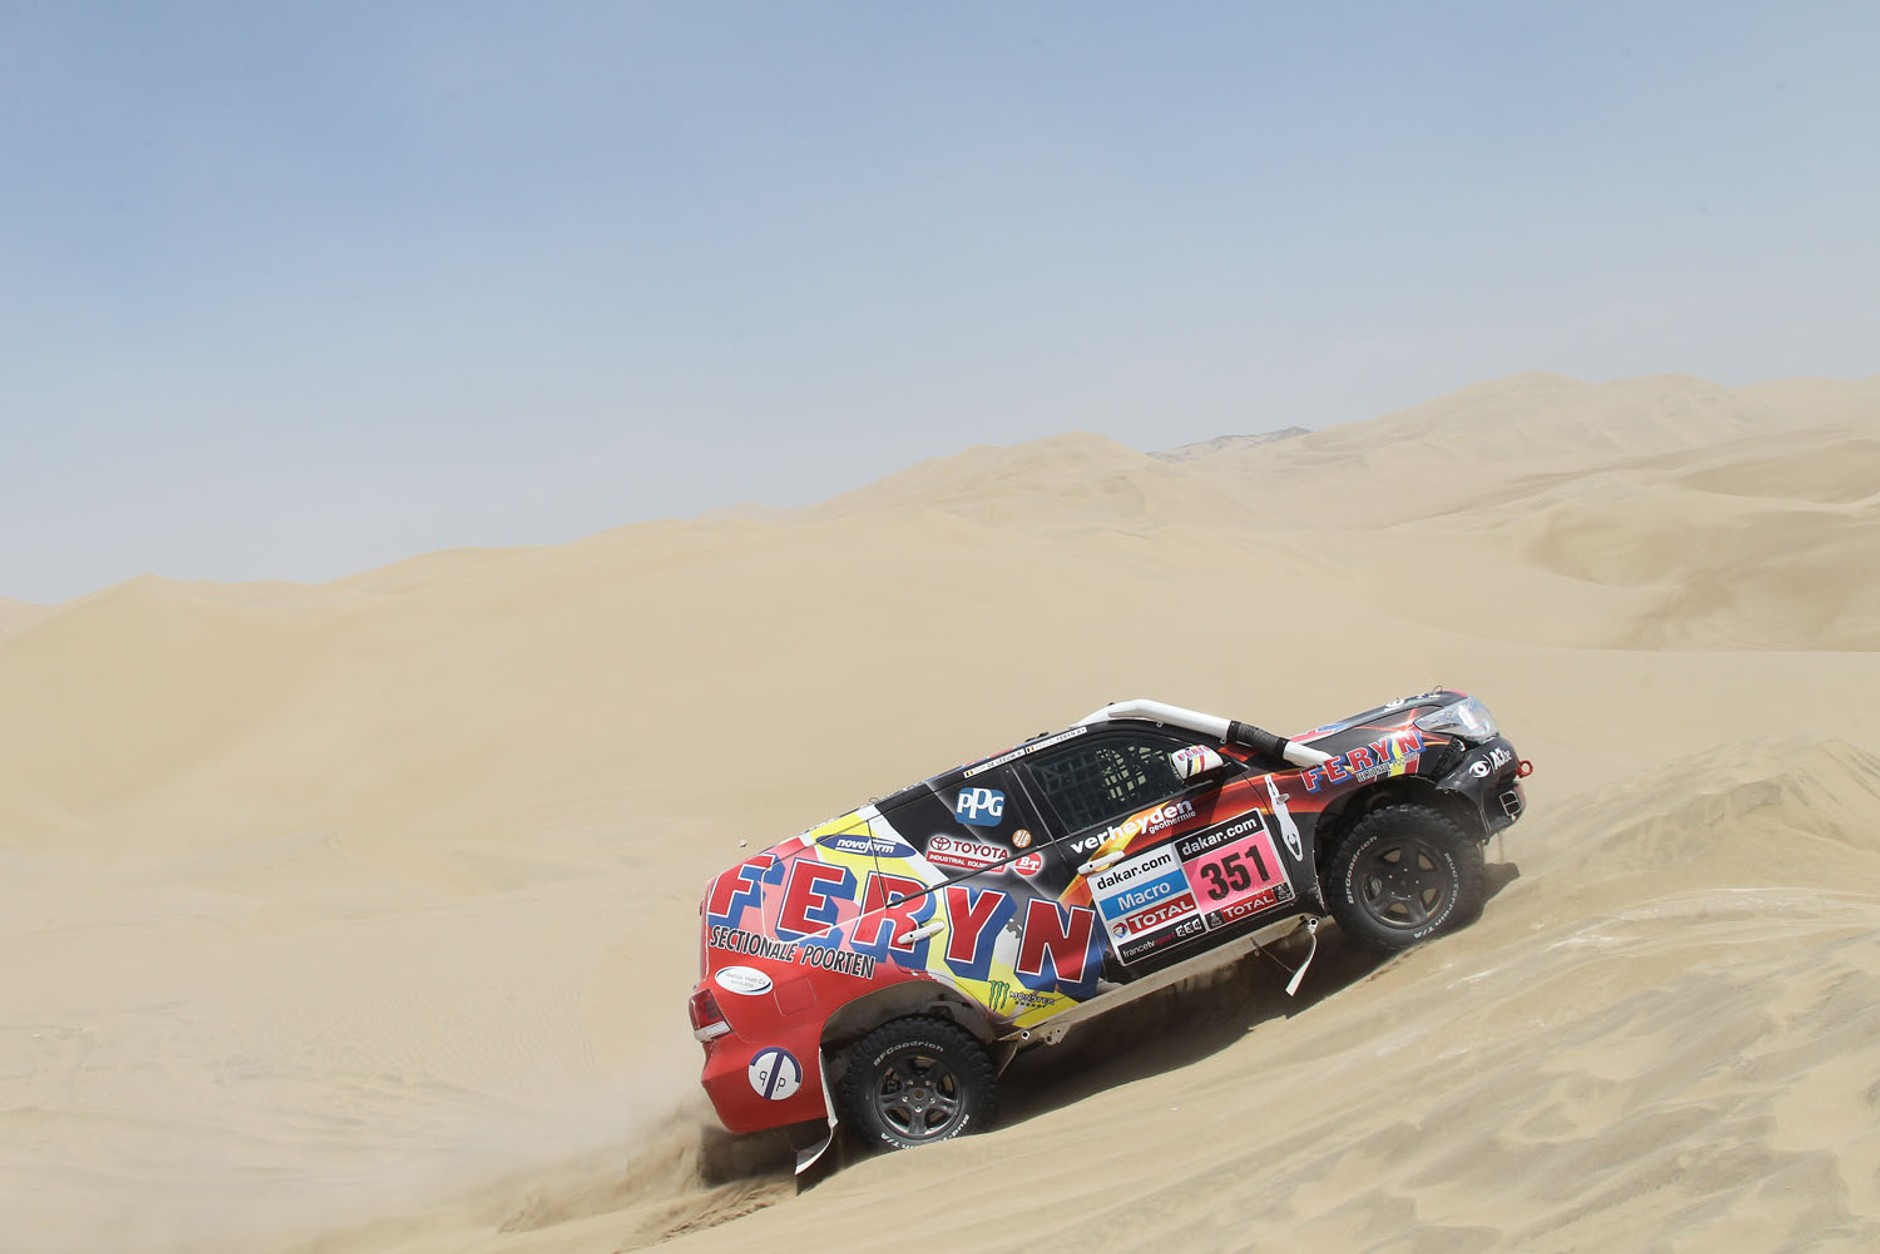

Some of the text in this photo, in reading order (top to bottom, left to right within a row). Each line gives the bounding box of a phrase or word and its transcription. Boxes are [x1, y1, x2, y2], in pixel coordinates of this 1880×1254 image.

[1300, 729, 1427, 793] FERYN
[956, 786, 1005, 819] PPG
[1070, 800, 1194, 854] verheyden
[1148, 810, 1196, 835] geothermie
[1181, 818, 1258, 856] dakar.com
[836, 839, 895, 854] novoferm
[929, 853, 966, 866] INDUSTRIAL
[953, 840, 1008, 860] TOYOTA
[1018, 854, 1040, 871] BT
[1097, 853, 1172, 890] dakar.com
[1200, 844, 1271, 901] 351
[1118, 881, 1171, 911] Macro
[1223, 895, 1275, 918] TOTAL
[705, 852, 1098, 988] FERYN
[1129, 901, 1194, 930] TOTAL
[710, 924, 877, 980] SECTIONALE POORTEN
